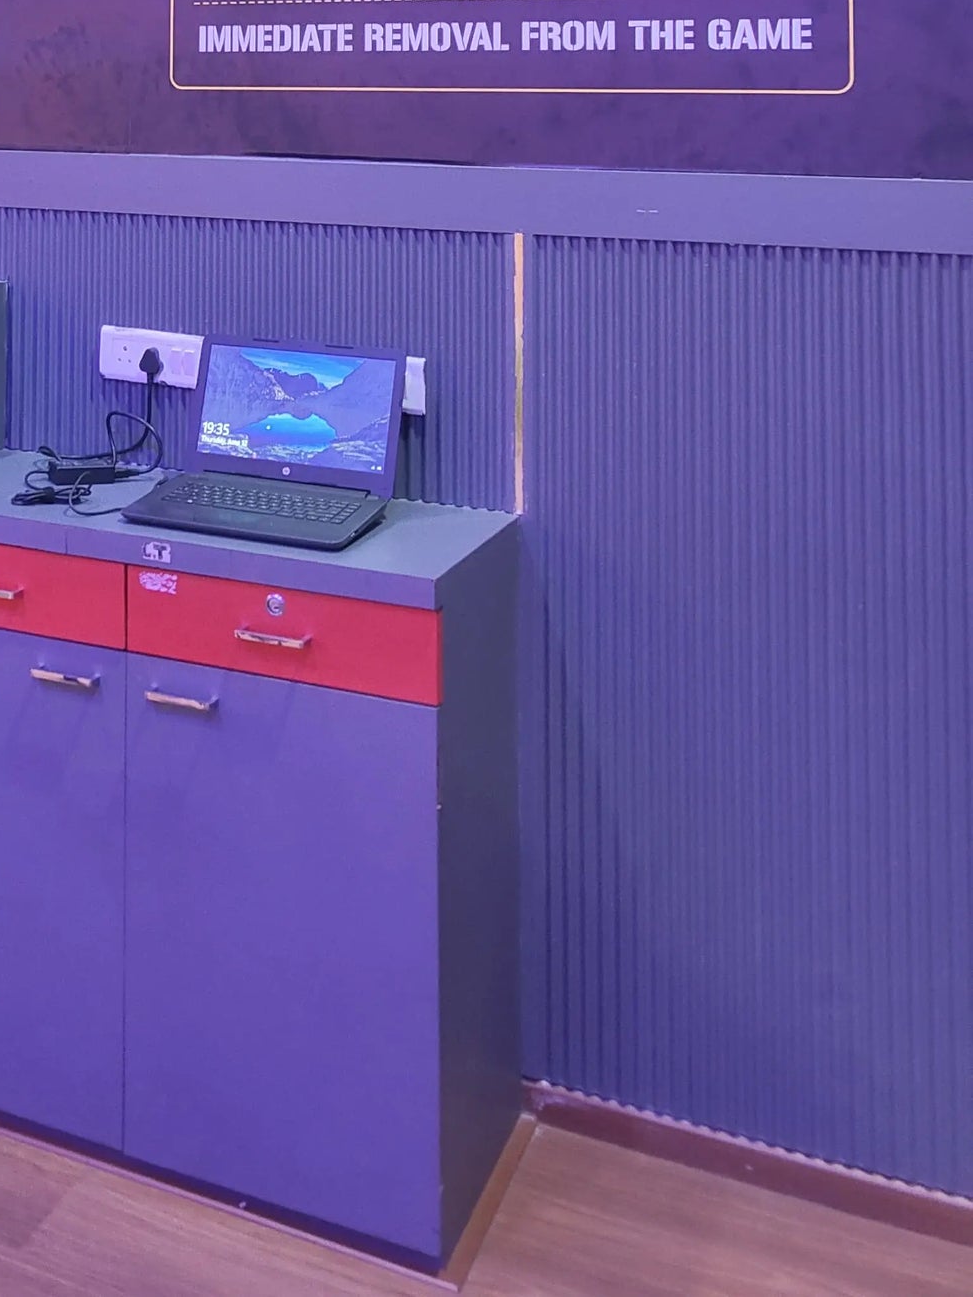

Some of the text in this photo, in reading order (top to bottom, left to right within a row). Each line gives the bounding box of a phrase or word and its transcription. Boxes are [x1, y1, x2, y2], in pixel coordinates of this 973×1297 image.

[199, 19, 812, 52] IMMEDIATE REMOVAL FROM THE GAME
[202, 421, 230, 436] 19:35
